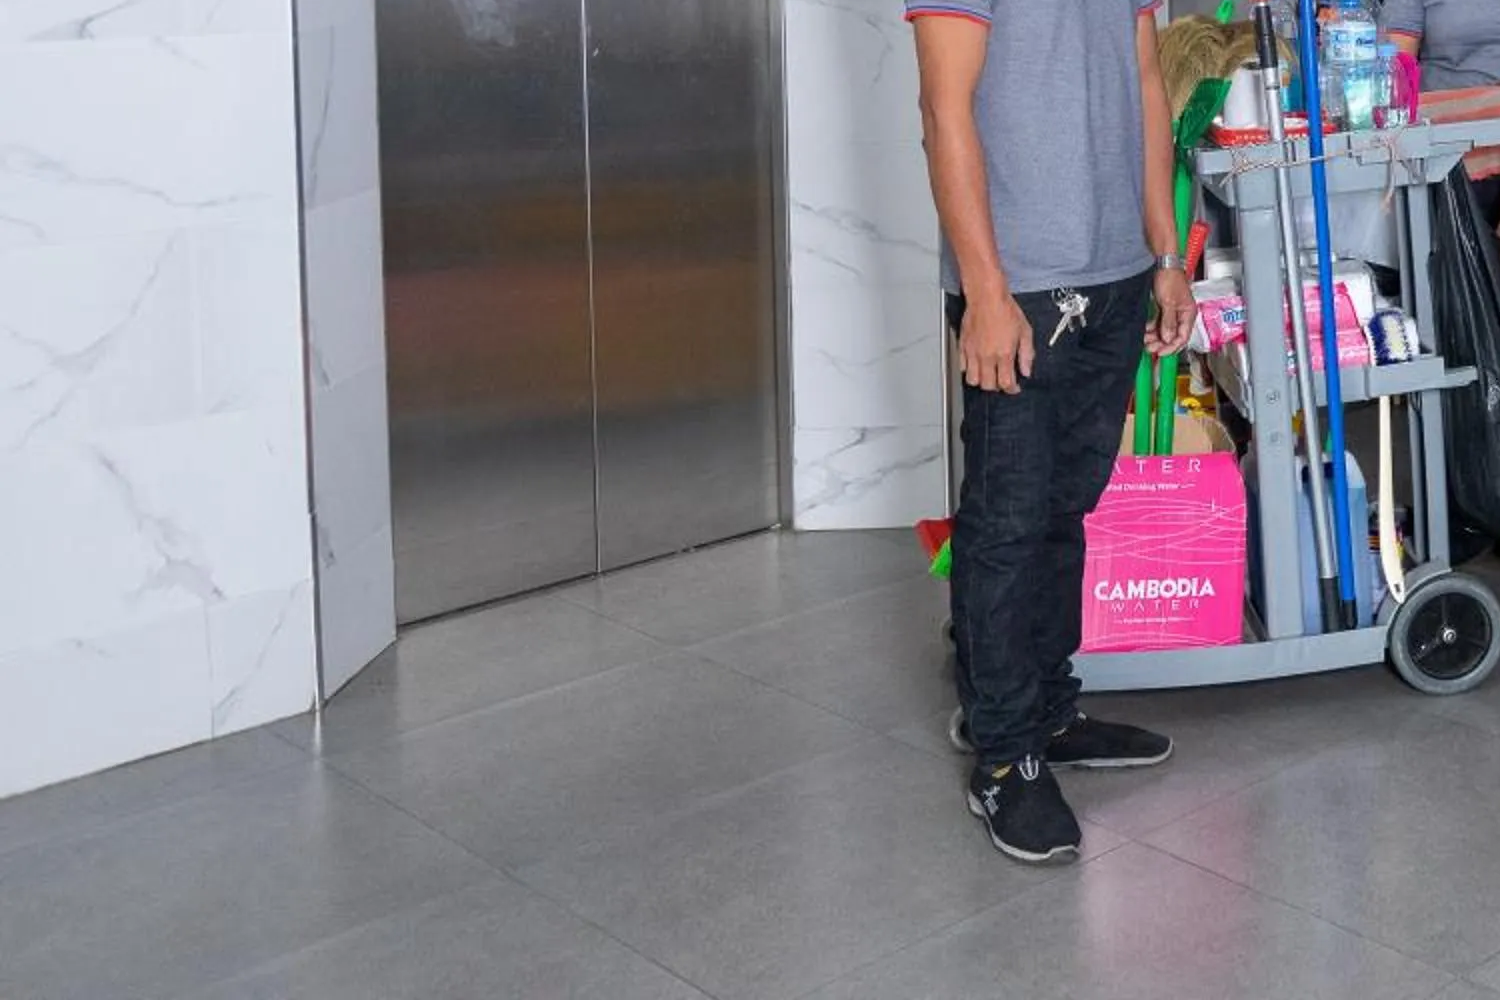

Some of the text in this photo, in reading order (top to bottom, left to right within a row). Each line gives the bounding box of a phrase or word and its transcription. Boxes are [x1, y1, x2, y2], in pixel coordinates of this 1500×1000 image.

[1114, 457, 1201, 475] TER
[1093, 577, 1216, 601] CAMBODIA
[1111, 598, 1200, 613] WATER
